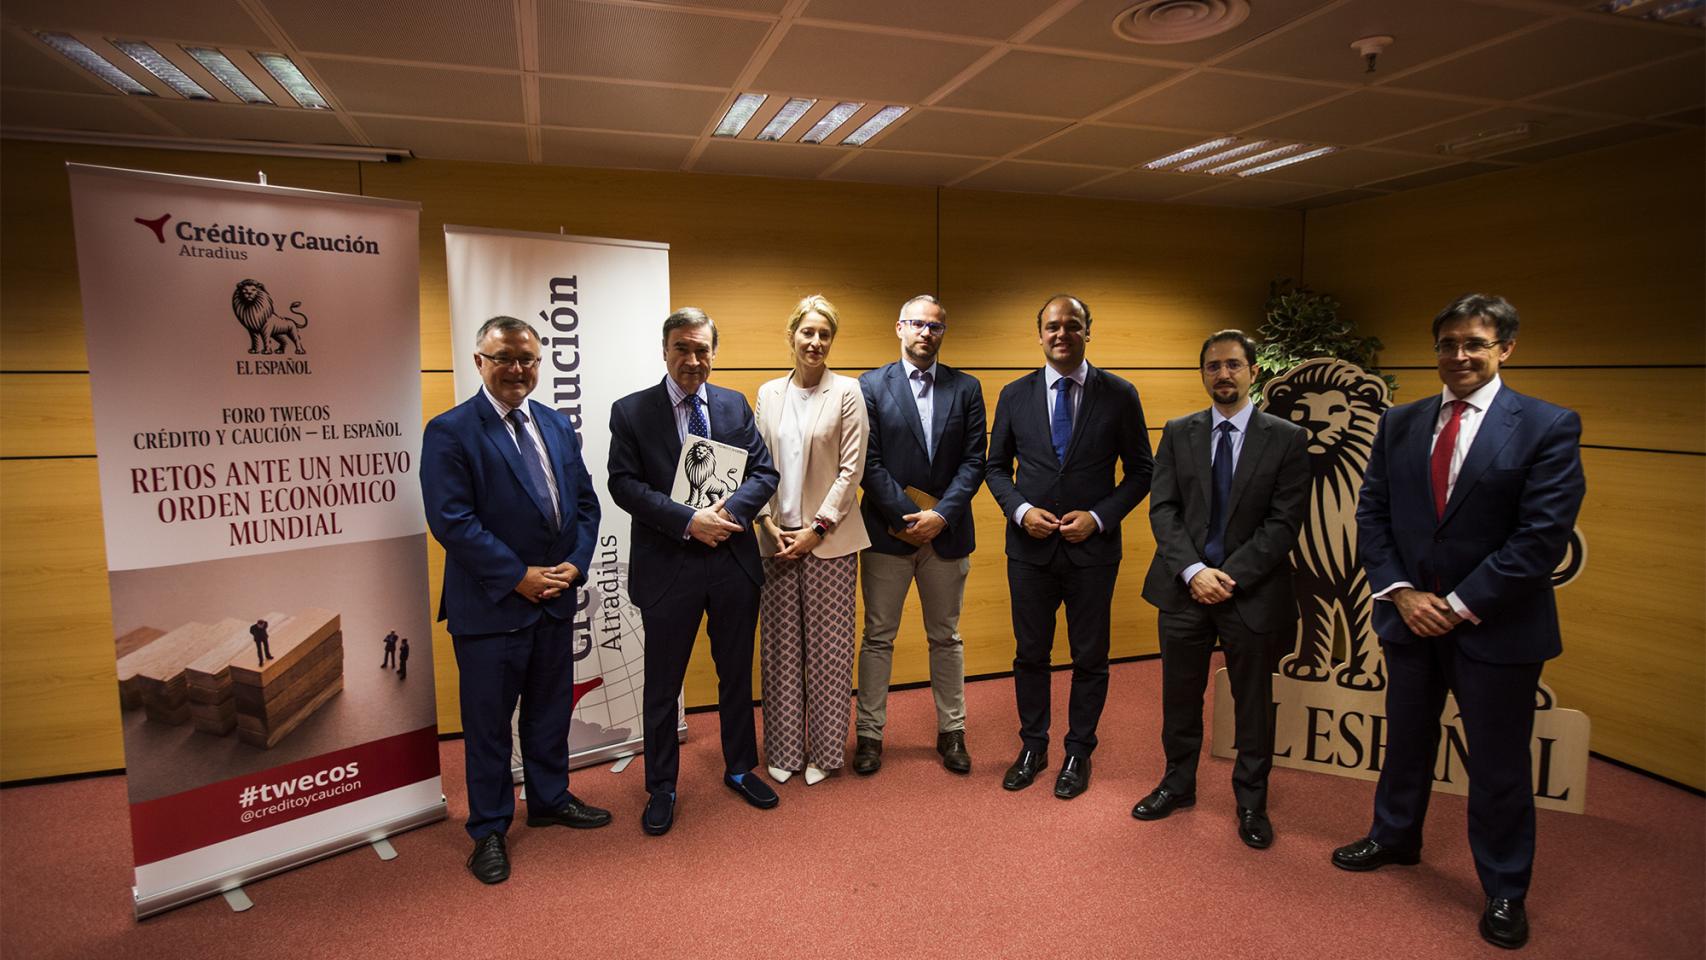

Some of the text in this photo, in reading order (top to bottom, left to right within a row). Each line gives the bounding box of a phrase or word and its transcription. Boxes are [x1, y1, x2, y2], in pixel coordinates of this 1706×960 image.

[175, 221, 380, 255] Crédito y Caución
[179, 244, 248, 261] Atradius
[236, 357, 312, 375] EL ESPAÑOL
[539, 275, 583, 450] aución
[222, 405, 330, 424] FORO TWECOS
[133, 428, 210, 450] CRÉDITO
[216, 430, 226, 446] Y
[232, 423, 301, 445] CAUCIÓN
[322, 425, 339, 440] EL
[343, 420, 402, 439] ESPAÑOL
[131, 450, 411, 494] RETOS ANTE UN NUEVO
[158, 479, 396, 524] ORDEN ECONÓMICO
[229, 512, 342, 546] MUNDIAL
[597, 534, 622, 653] Atradius
[239, 761, 360, 809] #twecos
[240, 780, 362, 823] @creditoycaucion
